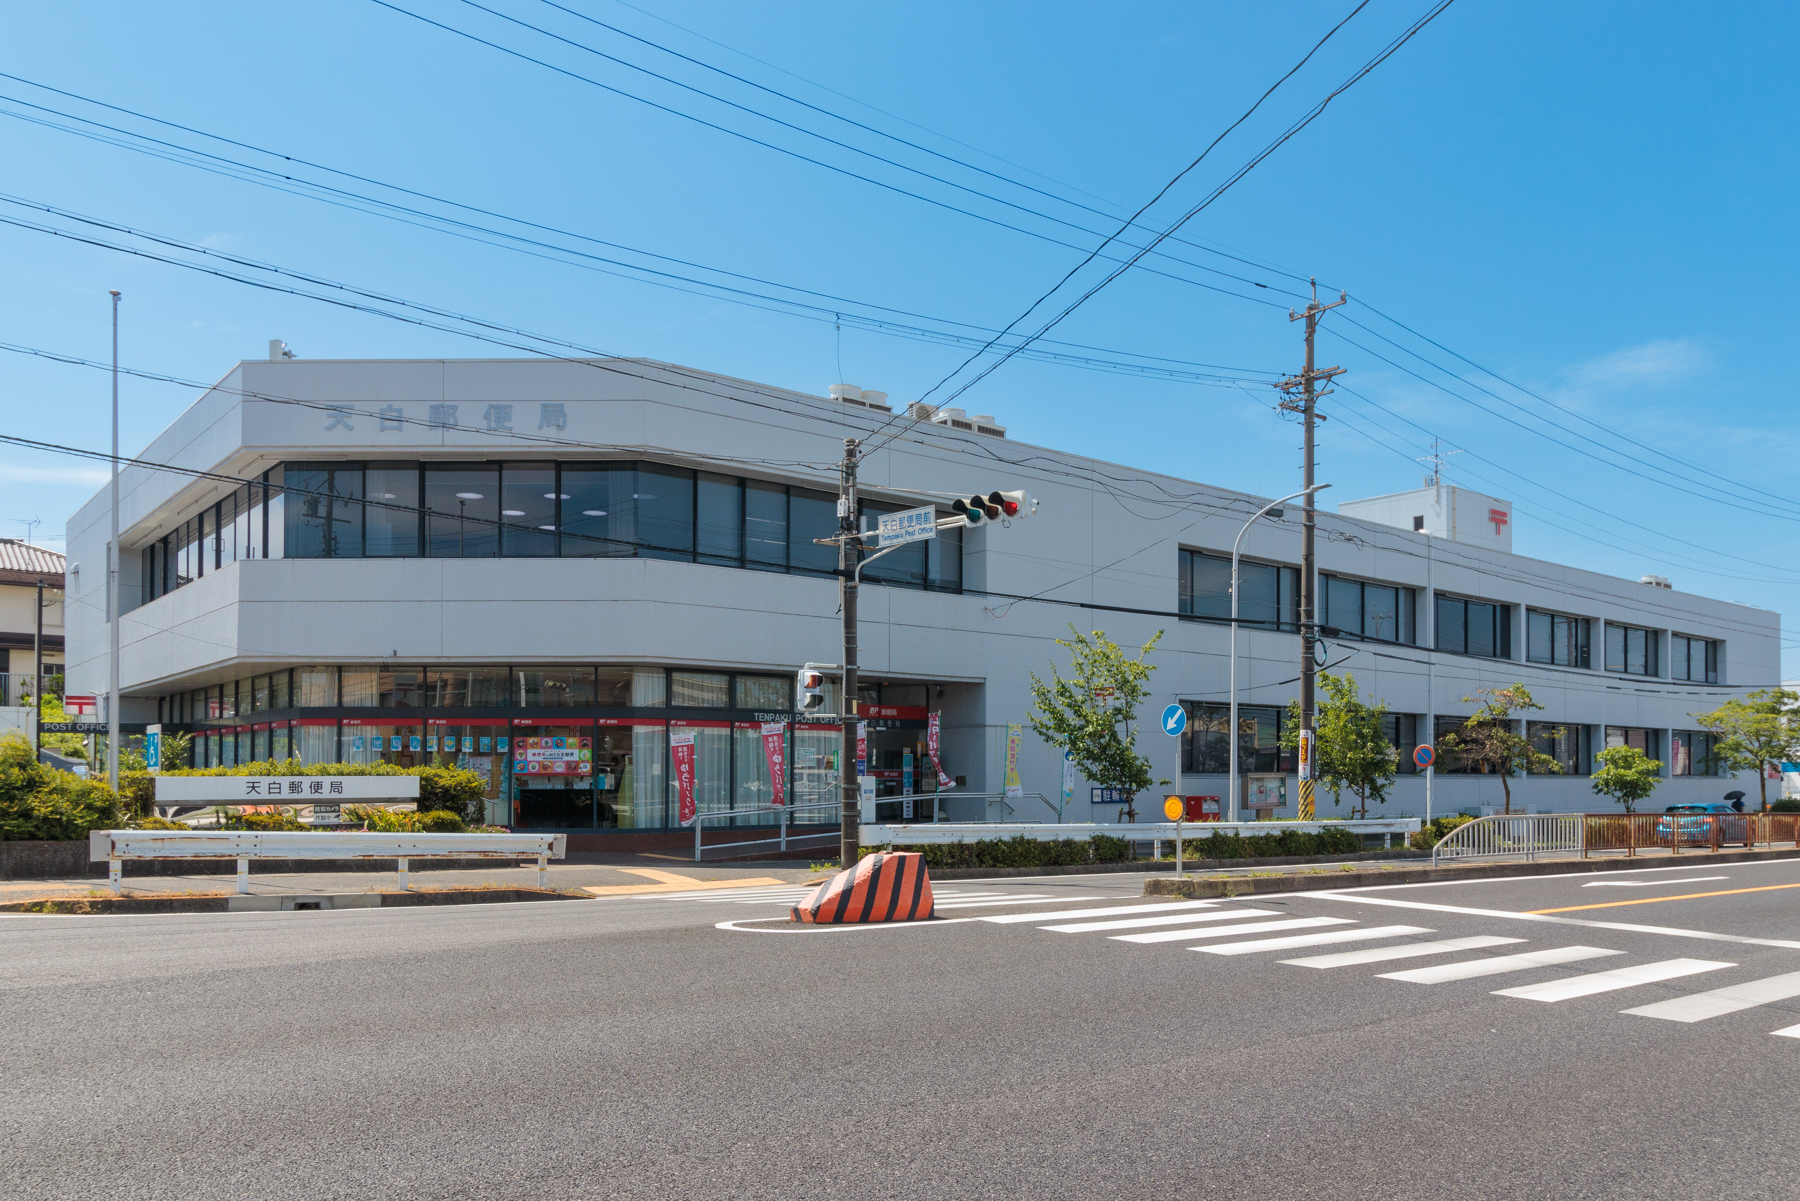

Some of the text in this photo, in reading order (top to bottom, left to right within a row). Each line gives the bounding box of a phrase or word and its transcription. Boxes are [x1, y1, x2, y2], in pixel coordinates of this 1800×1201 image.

[324, 403, 567, 431] 天白郵便局
[881, 511, 931, 532] 天白郵便局前
[881, 527, 933, 542] Tempaku Post Office
[754, 713, 791, 722] TENPAKU
[796, 714, 816, 723] POST
[881, 708, 897, 716] 郵便局
[44, 723, 73, 731] POST
[246, 781, 343, 795] 天白郵便局
